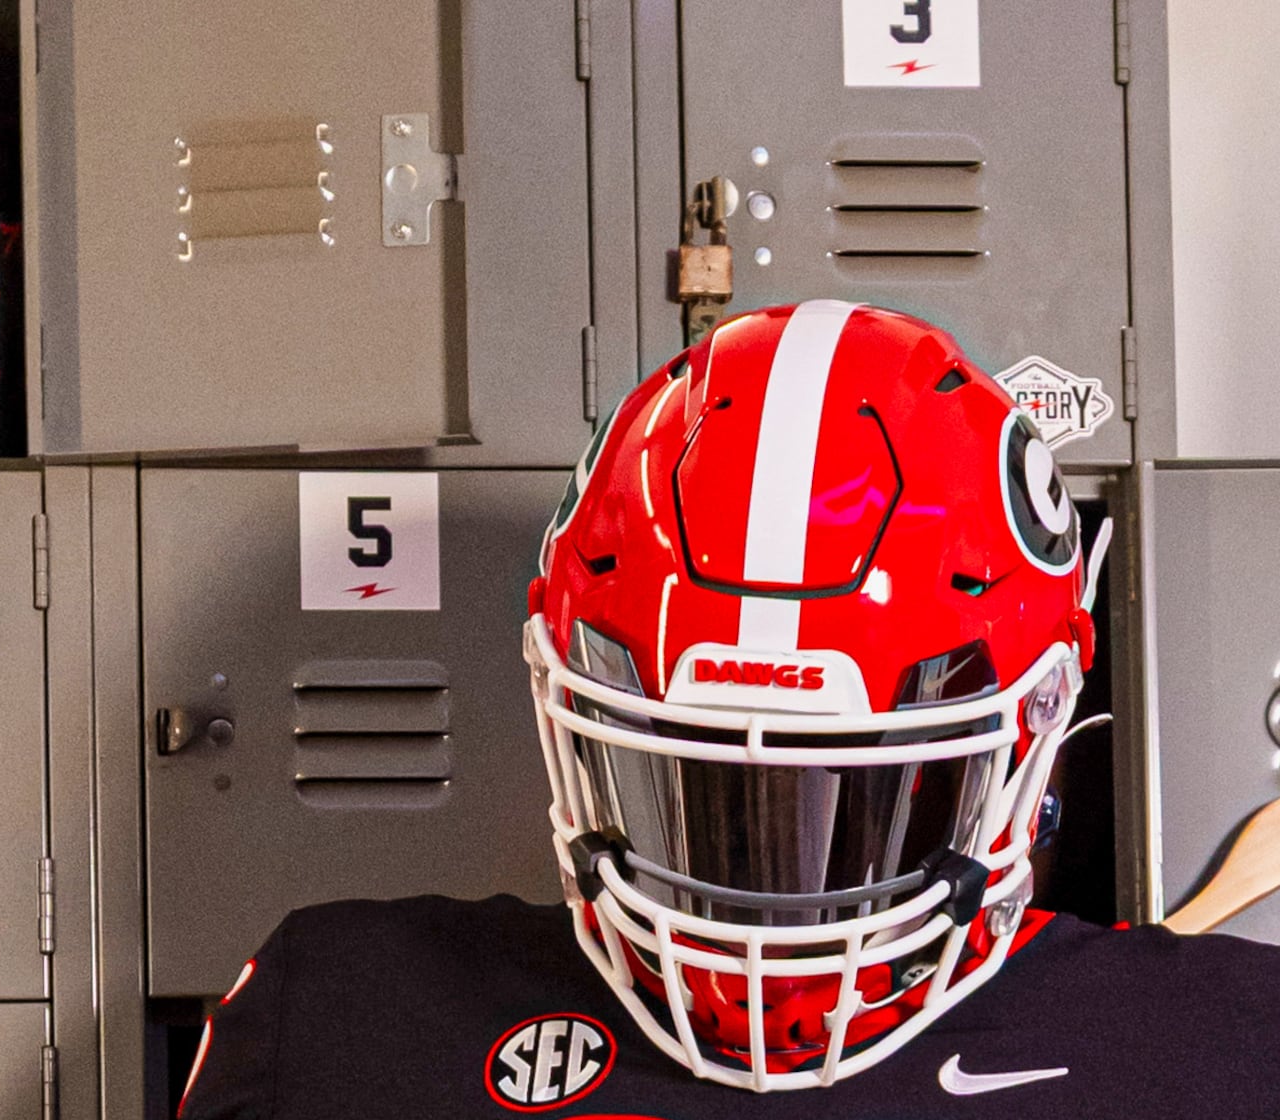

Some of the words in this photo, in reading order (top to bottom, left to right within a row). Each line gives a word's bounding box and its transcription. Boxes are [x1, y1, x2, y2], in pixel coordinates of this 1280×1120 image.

[890, 0, 931, 43] 3
[348, 496, 392, 567] 5
[690, 659, 824, 690] DAWGS
[498, 1019, 604, 1103] SEC
